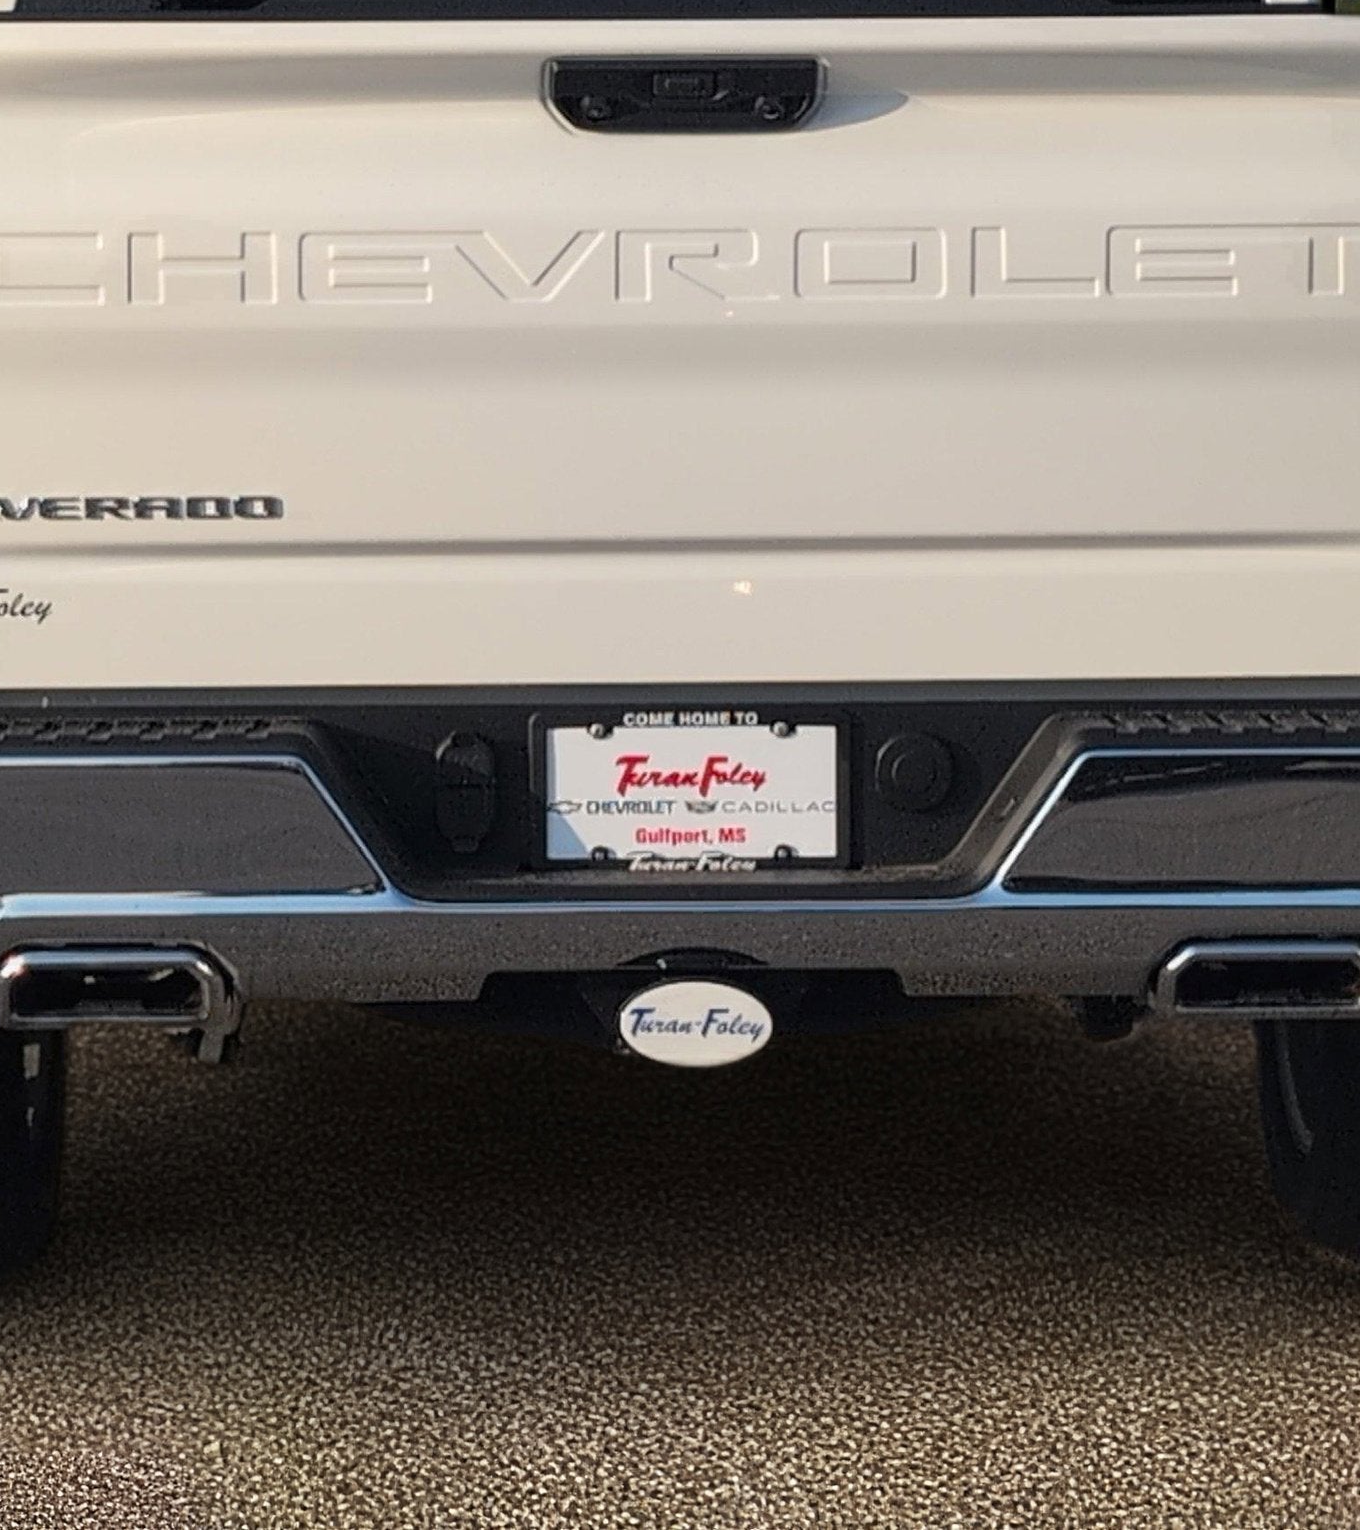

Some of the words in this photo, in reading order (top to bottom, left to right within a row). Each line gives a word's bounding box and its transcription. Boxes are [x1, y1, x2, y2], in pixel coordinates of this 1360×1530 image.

[622, 711, 674, 726] COME
[678, 711, 731, 726] HOME
[734, 711, 759, 726] TO
[586, 800, 677, 815] CHEVROLET
[721, 800, 836, 814] CADILLAC
[635, 827, 714, 846] Gulfport,
[718, 827, 747, 844] MS
